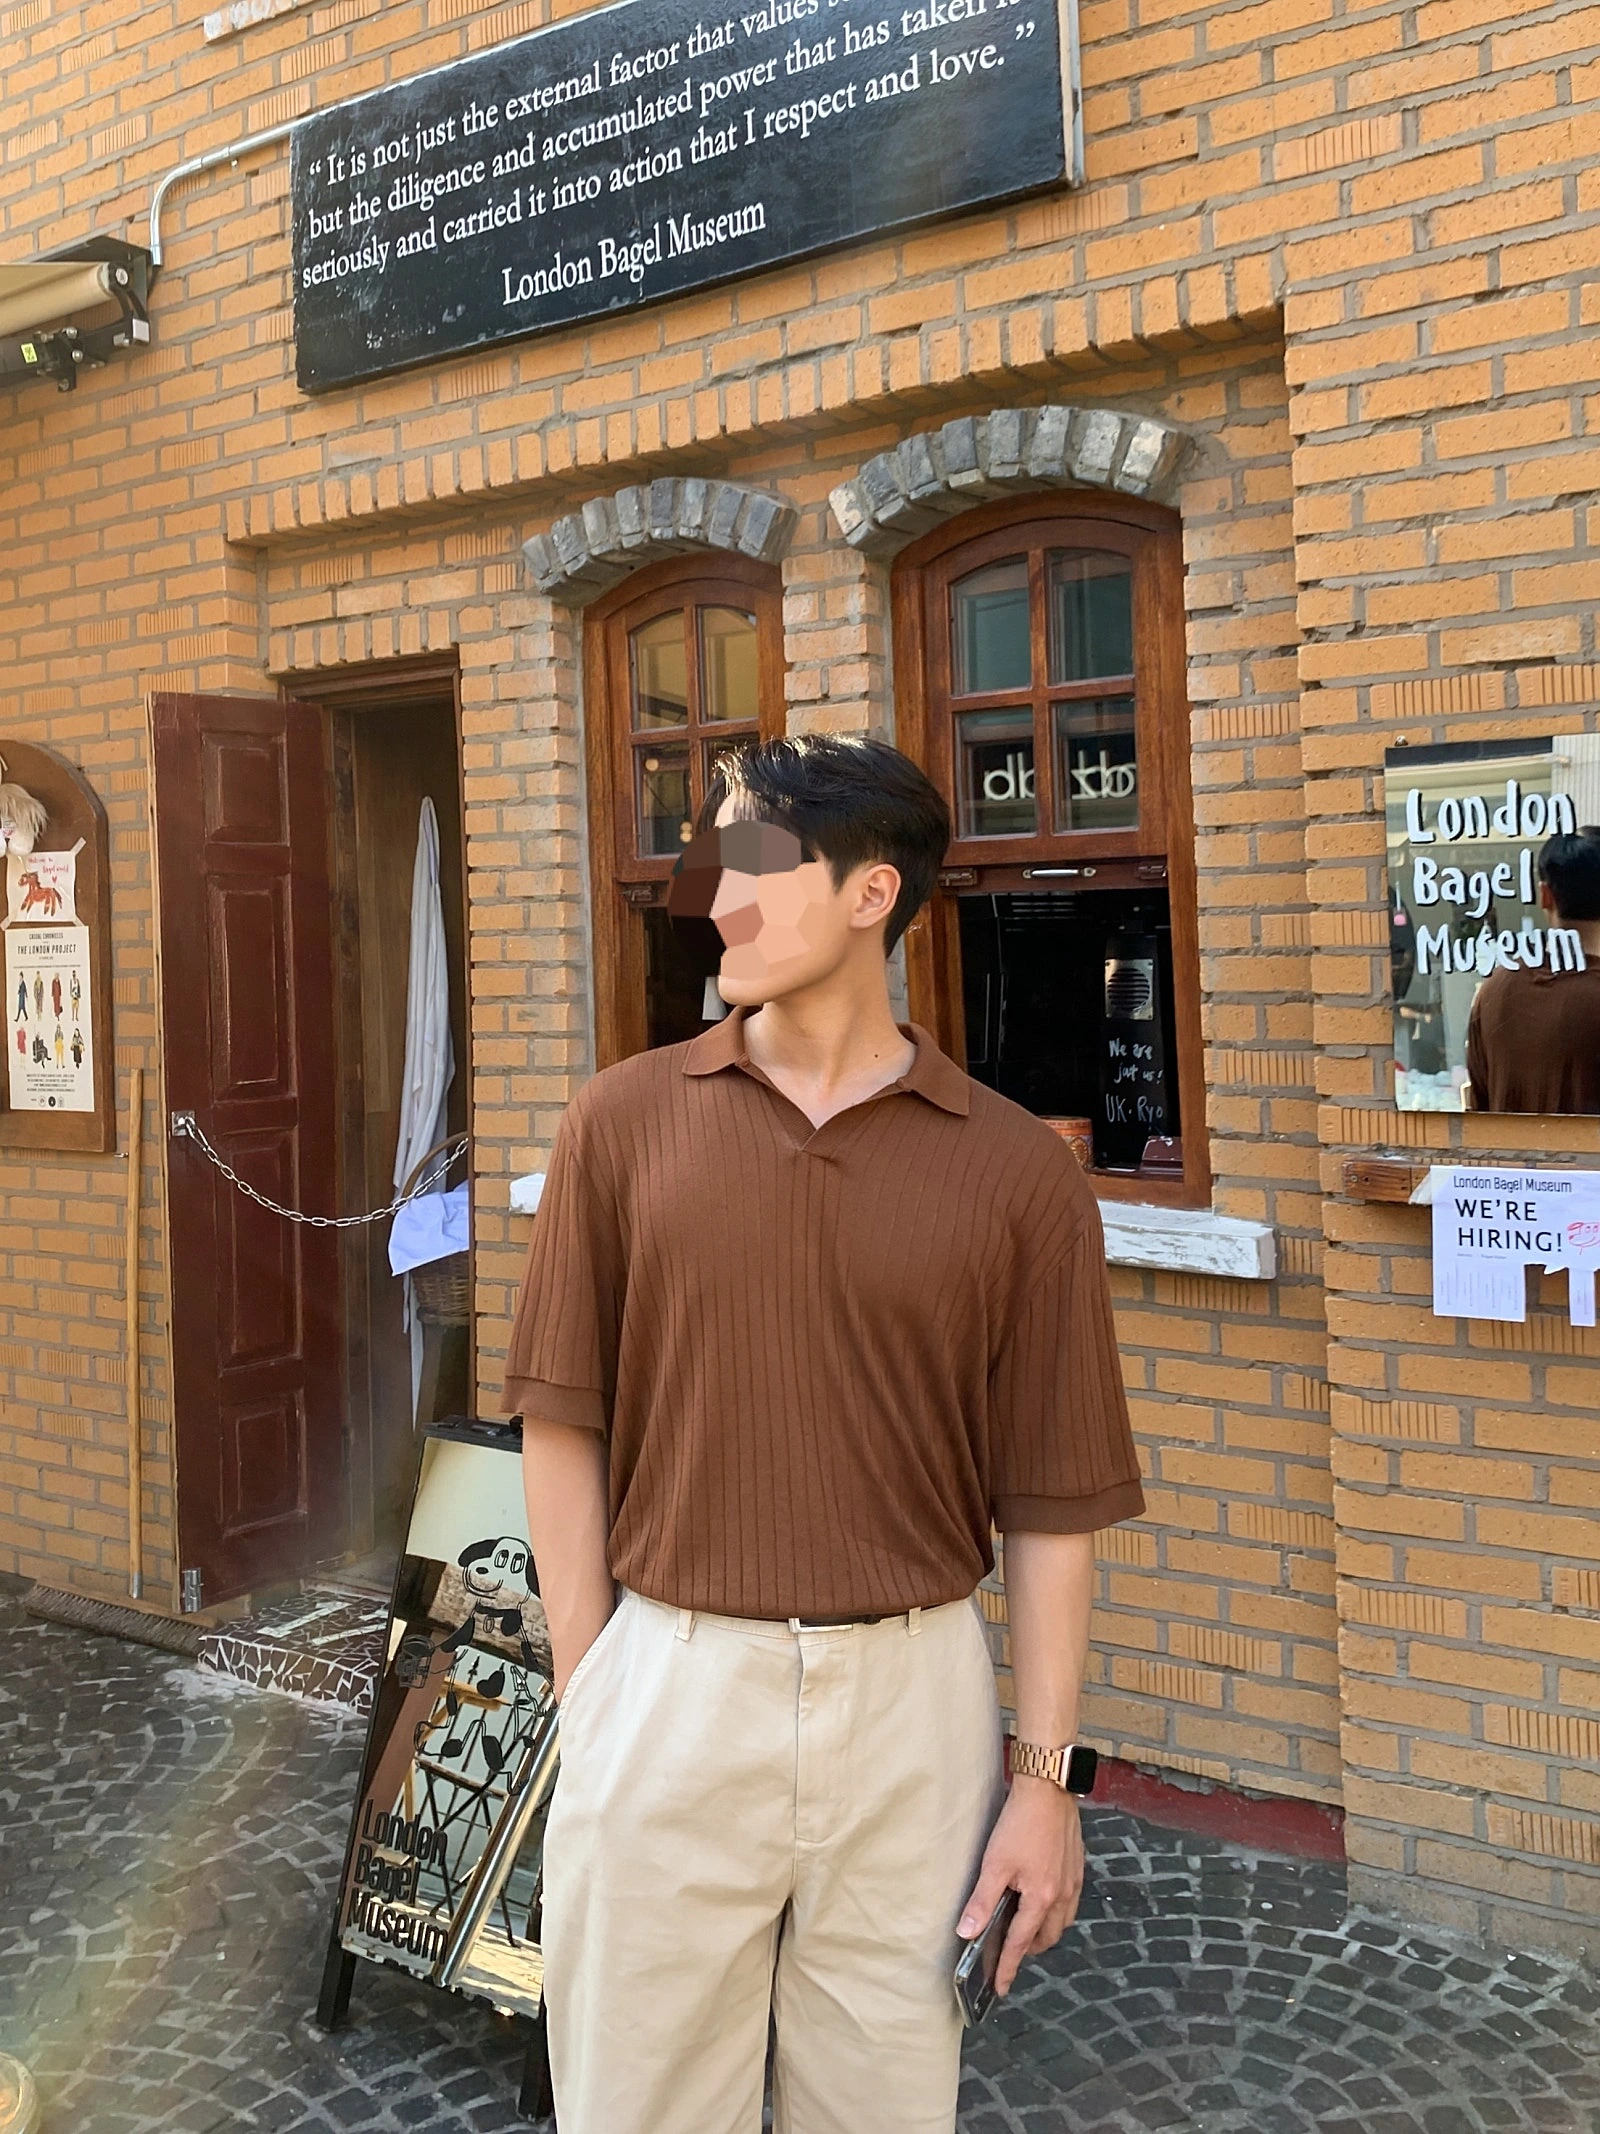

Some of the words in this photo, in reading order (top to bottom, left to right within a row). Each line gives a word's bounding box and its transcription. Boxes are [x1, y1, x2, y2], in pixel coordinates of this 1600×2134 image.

[350, 146, 366, 177] is
[373, 134, 410, 168] not
[415, 119, 455, 164] just
[462, 101, 498, 136] the
[504, 61, 601, 120] external
[609, 42, 680, 86] factor
[687, 19, 735, 58] that
[740, 0, 819, 38] values
[308, 207, 343, 239] but
[350, 192, 382, 226] the
[387, 160, 485, 212] diligence
[492, 131, 535, 178] and
[542, 78, 693, 161] accumulated
[699, 58, 777, 118] power
[784, 35, 836, 75] that
[843, 20, 890, 56] has
[302, 235, 390, 288] seriously
[396, 216, 436, 259] and
[442, 188, 522, 243] carried
[528, 184, 546, 218] it
[552, 175, 601, 210] into
[609, 146, 683, 193] action
[690, 122, 738, 165] that
[744, 107, 756, 145] I
[763, 81, 857, 139] respect
[864, 52, 920, 103] and
[930, 44, 1005, 85] love.
[502, 251, 593, 305] London
[598, 221, 662, 283] Bagel
[666, 200, 766, 259] Museum
[1405, 779, 1576, 843] London
[1412, 848, 1537, 918] Bagel
[18, 946, 27, 954] THE
[29, 945, 50, 954] LONDON
[52, 944, 76, 954] PROJECT
[1416, 923, 1587, 976] Museum
[1109, 1038, 1127, 1058] We
[1453, 1175, 1492, 1189] London
[1494, 1177, 1522, 1193] Bagel
[1526, 1178, 1572, 1193] Museum
[1458, 1227, 1562, 1252] HIRING!
[362, 1798, 448, 1867] London
[354, 1843, 421, 1907] Bagel
[346, 1887, 449, 1965] Museum
